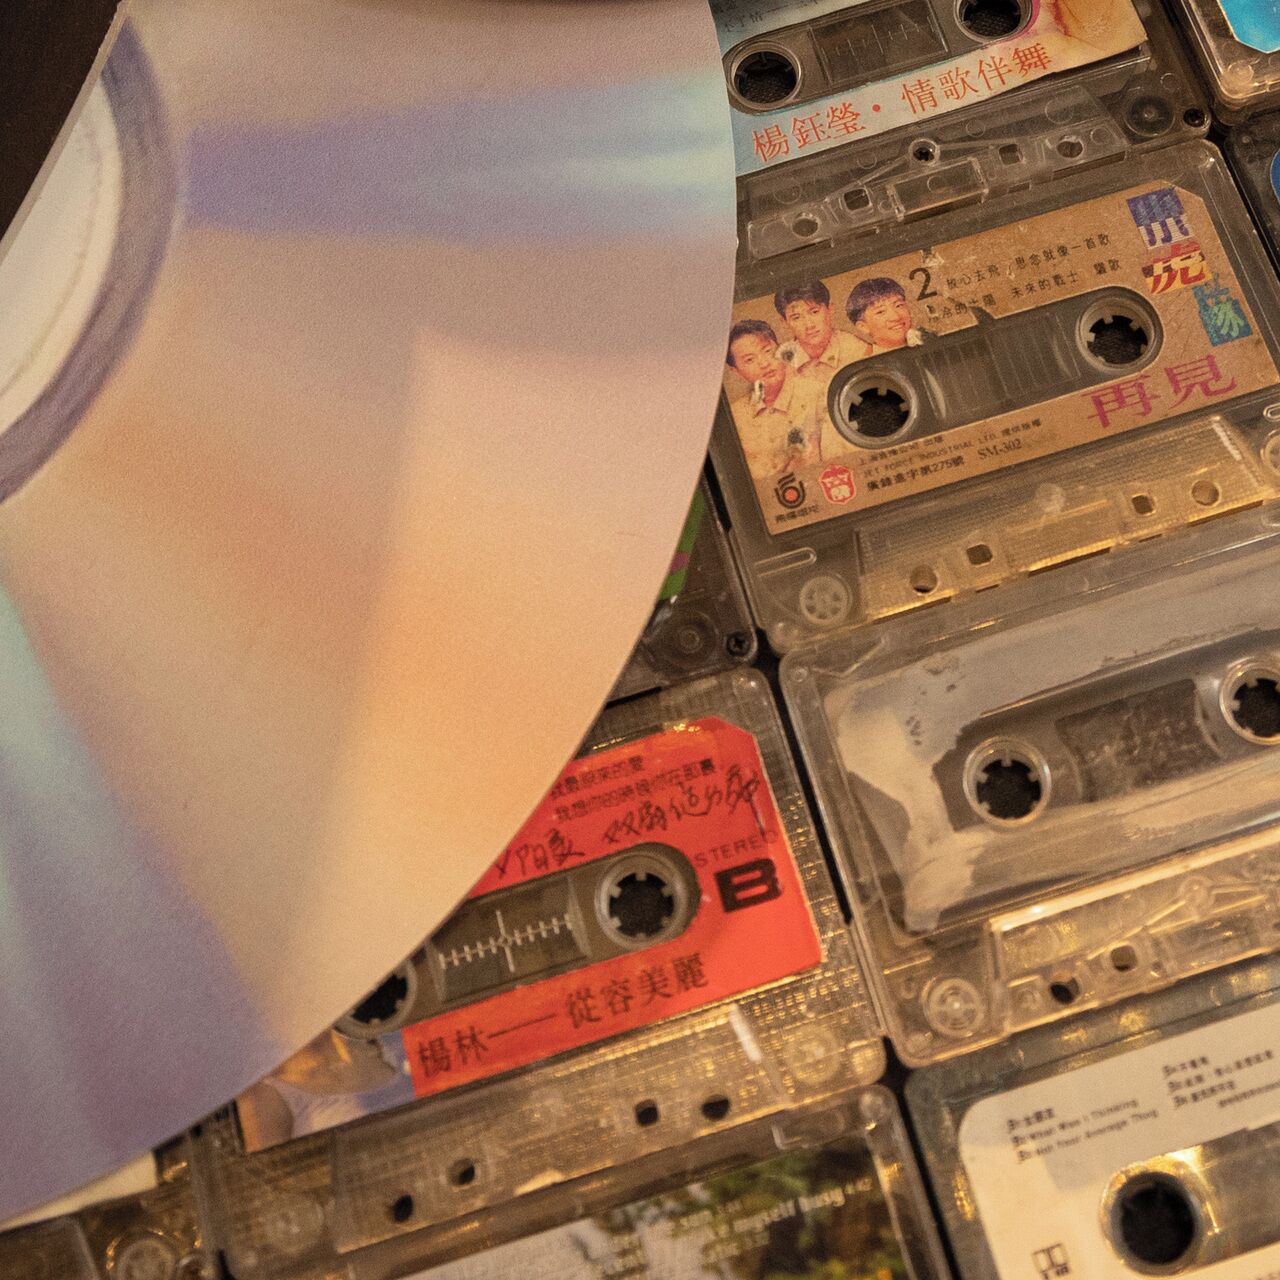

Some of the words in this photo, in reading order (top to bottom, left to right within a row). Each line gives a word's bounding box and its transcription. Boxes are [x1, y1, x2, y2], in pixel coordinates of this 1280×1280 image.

[909, 266, 938, 302] 2
[1082, 354, 1238, 429] 再見
[694, 830, 779, 869] STEREO
[712, 858, 782, 914] B
